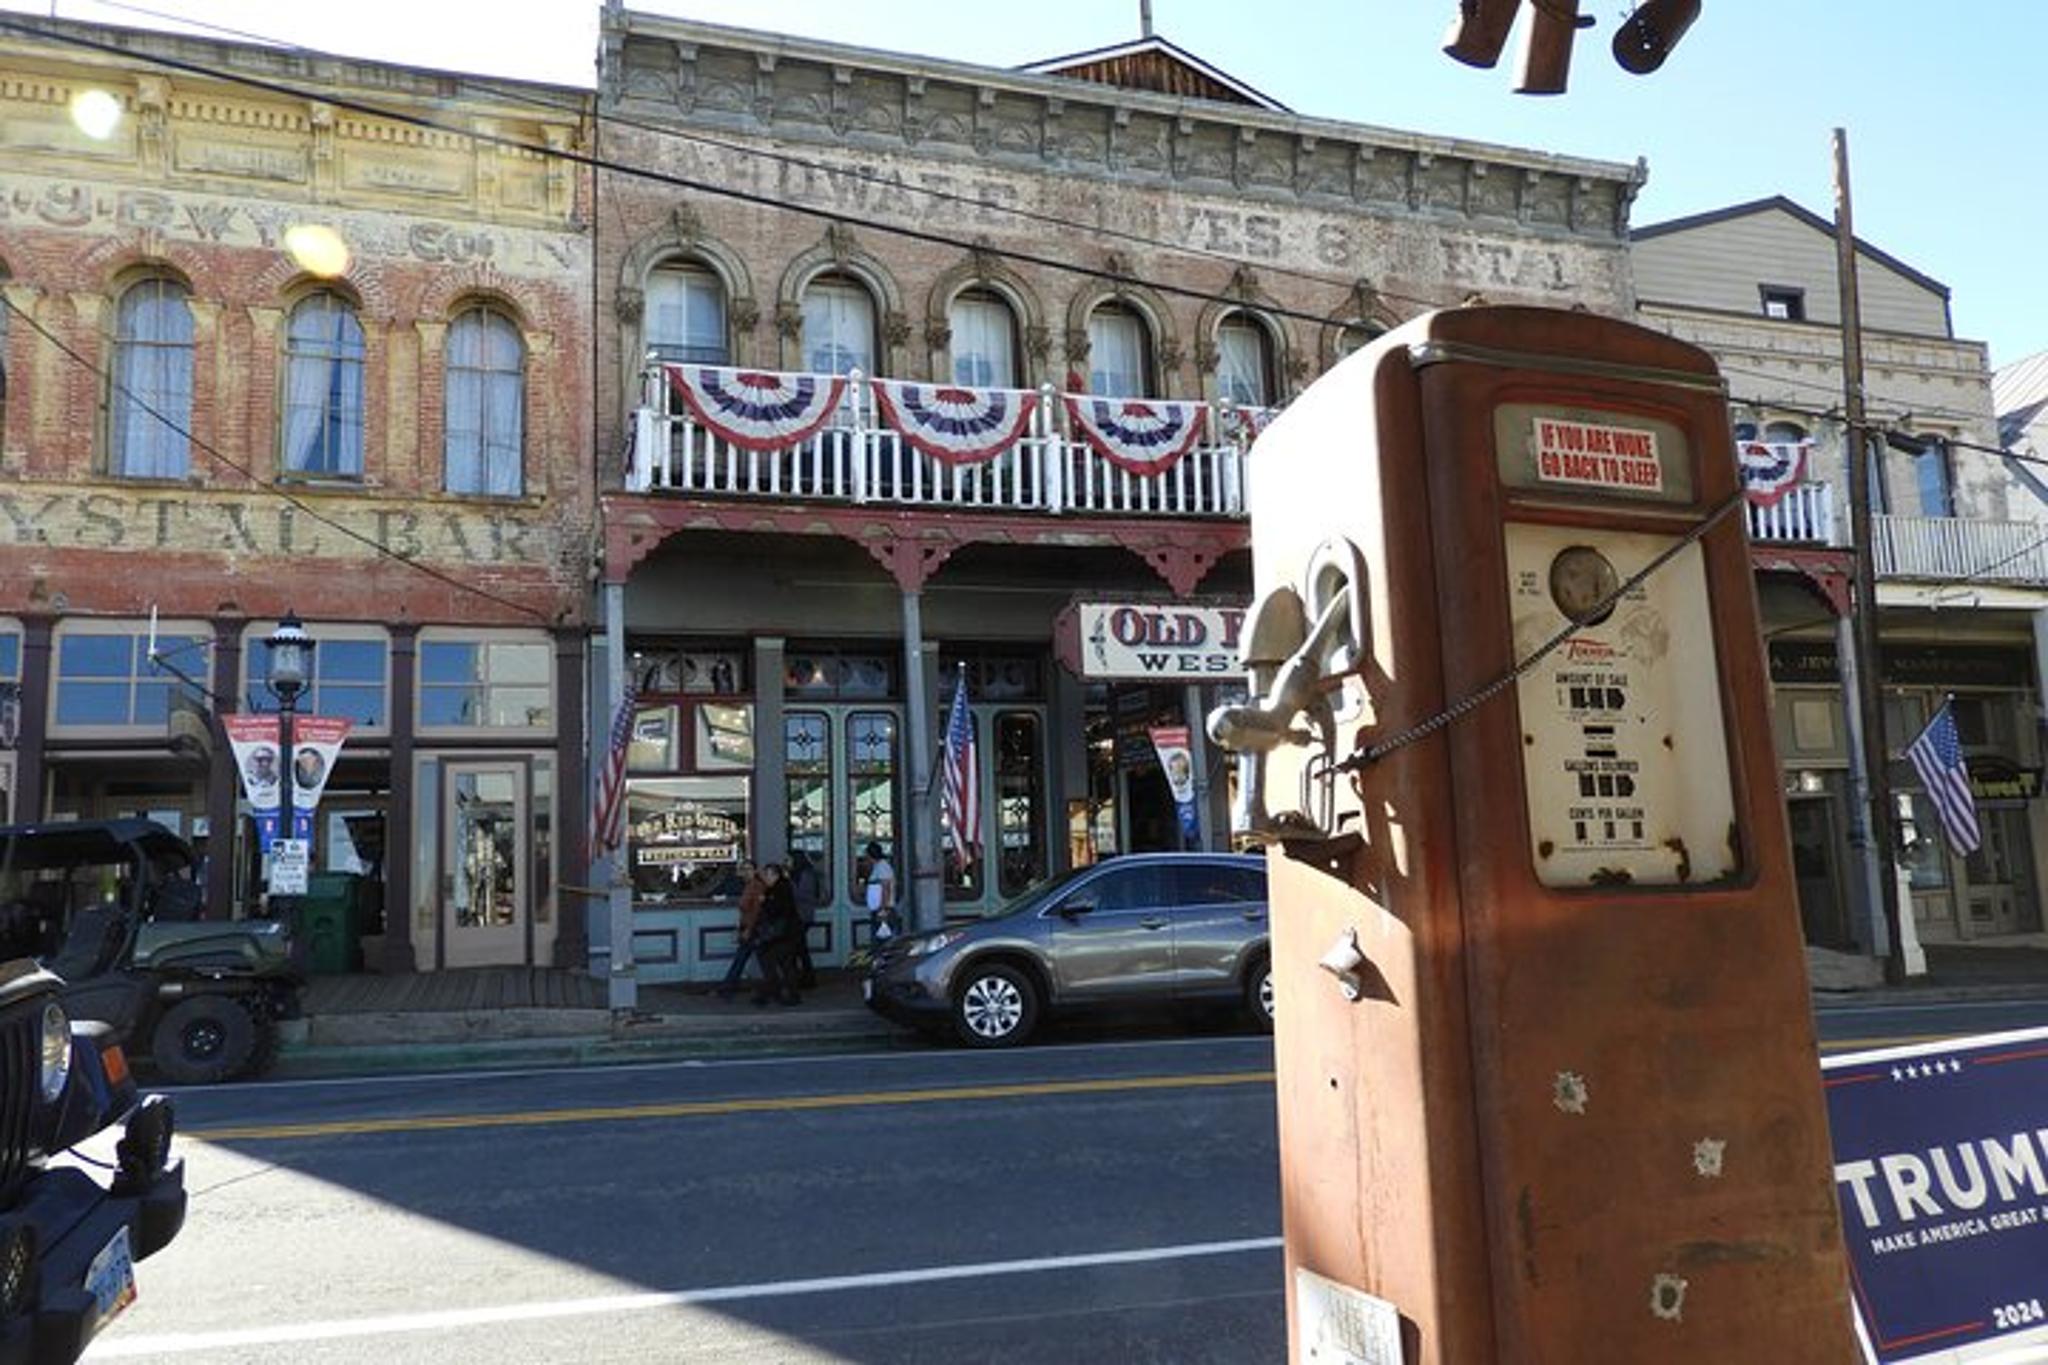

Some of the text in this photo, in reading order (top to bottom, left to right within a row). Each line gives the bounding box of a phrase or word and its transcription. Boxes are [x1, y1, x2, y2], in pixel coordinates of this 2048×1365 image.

[1541, 423, 1554, 448] IF
[1556, 425, 1583, 451] YOU
[1587, 428, 1612, 454] ARE
[1541, 452, 1658, 487] GO BACK TO SLEEP
[376, 508, 532, 563] BAR
[1111, 608, 1207, 647] OLD
[1870, 1231, 1918, 1254] MAKE
[1919, 1217, 1989, 1247] AMERICA
[1990, 1207, 2038, 1232] GREAT
[1993, 1299, 2045, 1330] 2024
